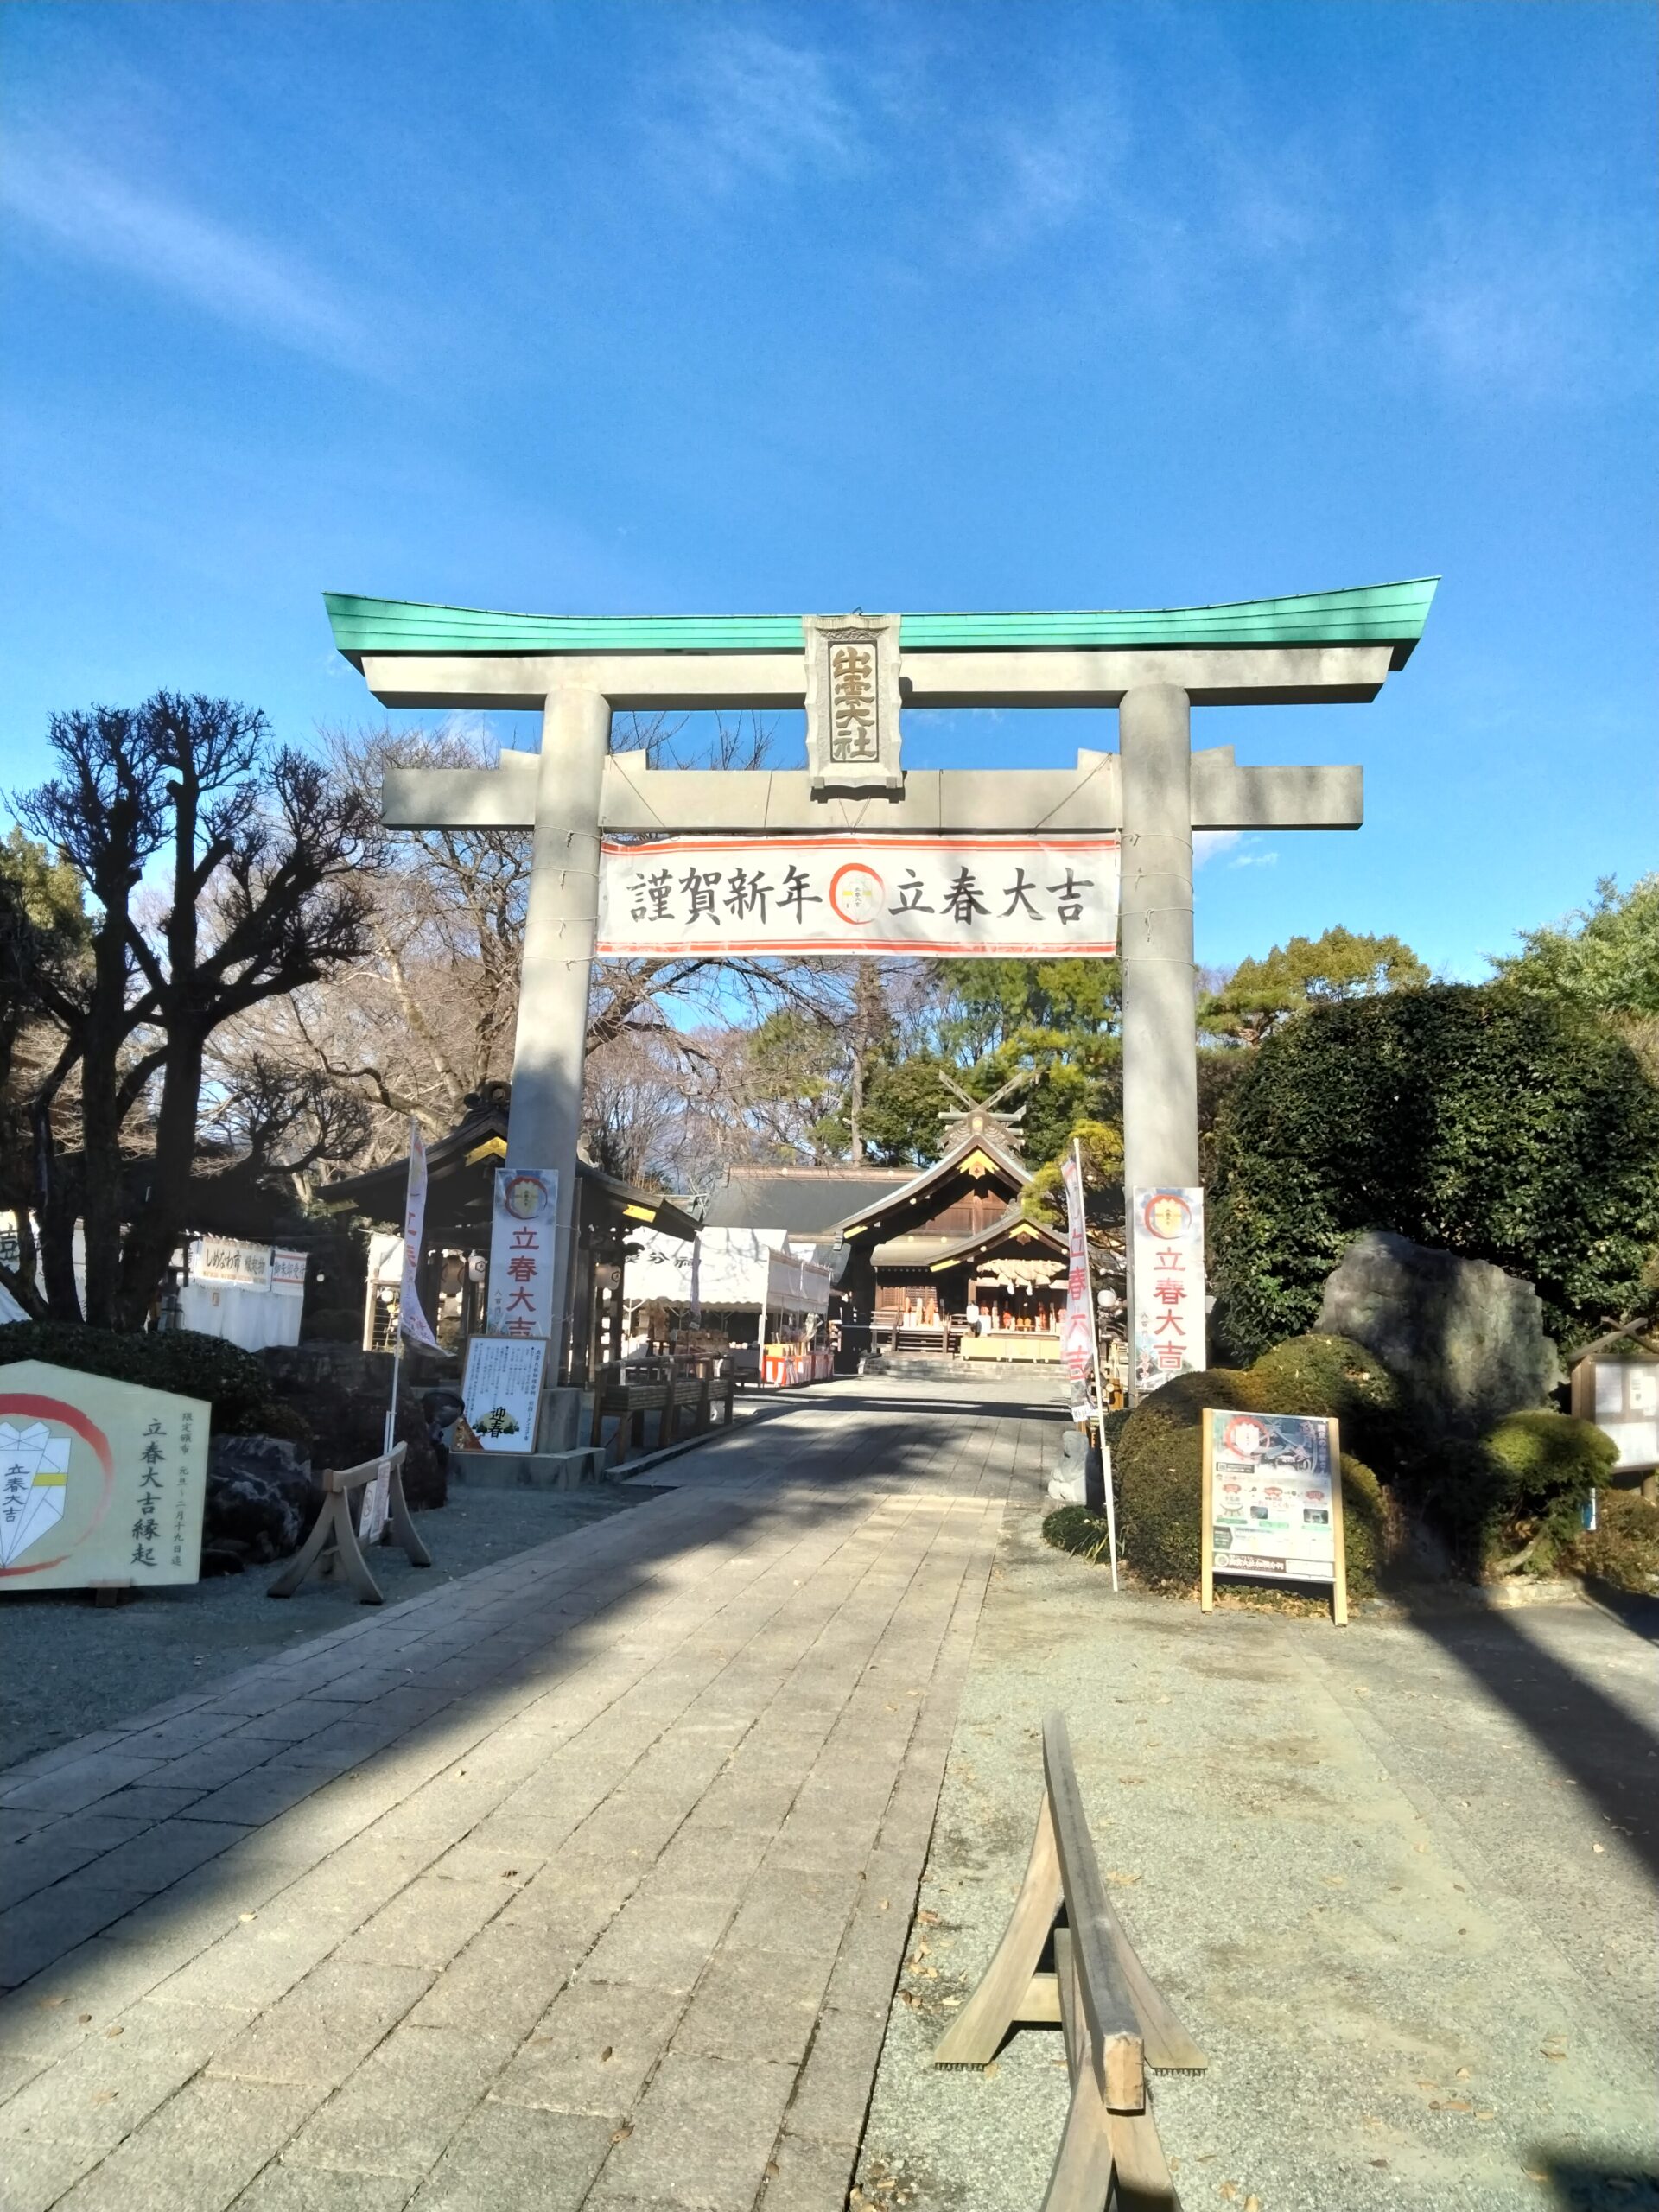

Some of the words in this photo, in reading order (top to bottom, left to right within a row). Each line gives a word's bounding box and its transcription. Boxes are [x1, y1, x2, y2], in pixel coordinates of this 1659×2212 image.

[832, 646, 877, 762] 出雲大社
[626, 865, 823, 925] 謹賀新年
[887, 865, 1095, 925] 立春大吉
[1153, 1246, 1189, 1370] 立春大吉
[488, 1406, 506, 1439] 迎春
[2, 1463, 31, 1522] 立春大吉
[130, 1418, 168, 1567] 立春大吉縁起
